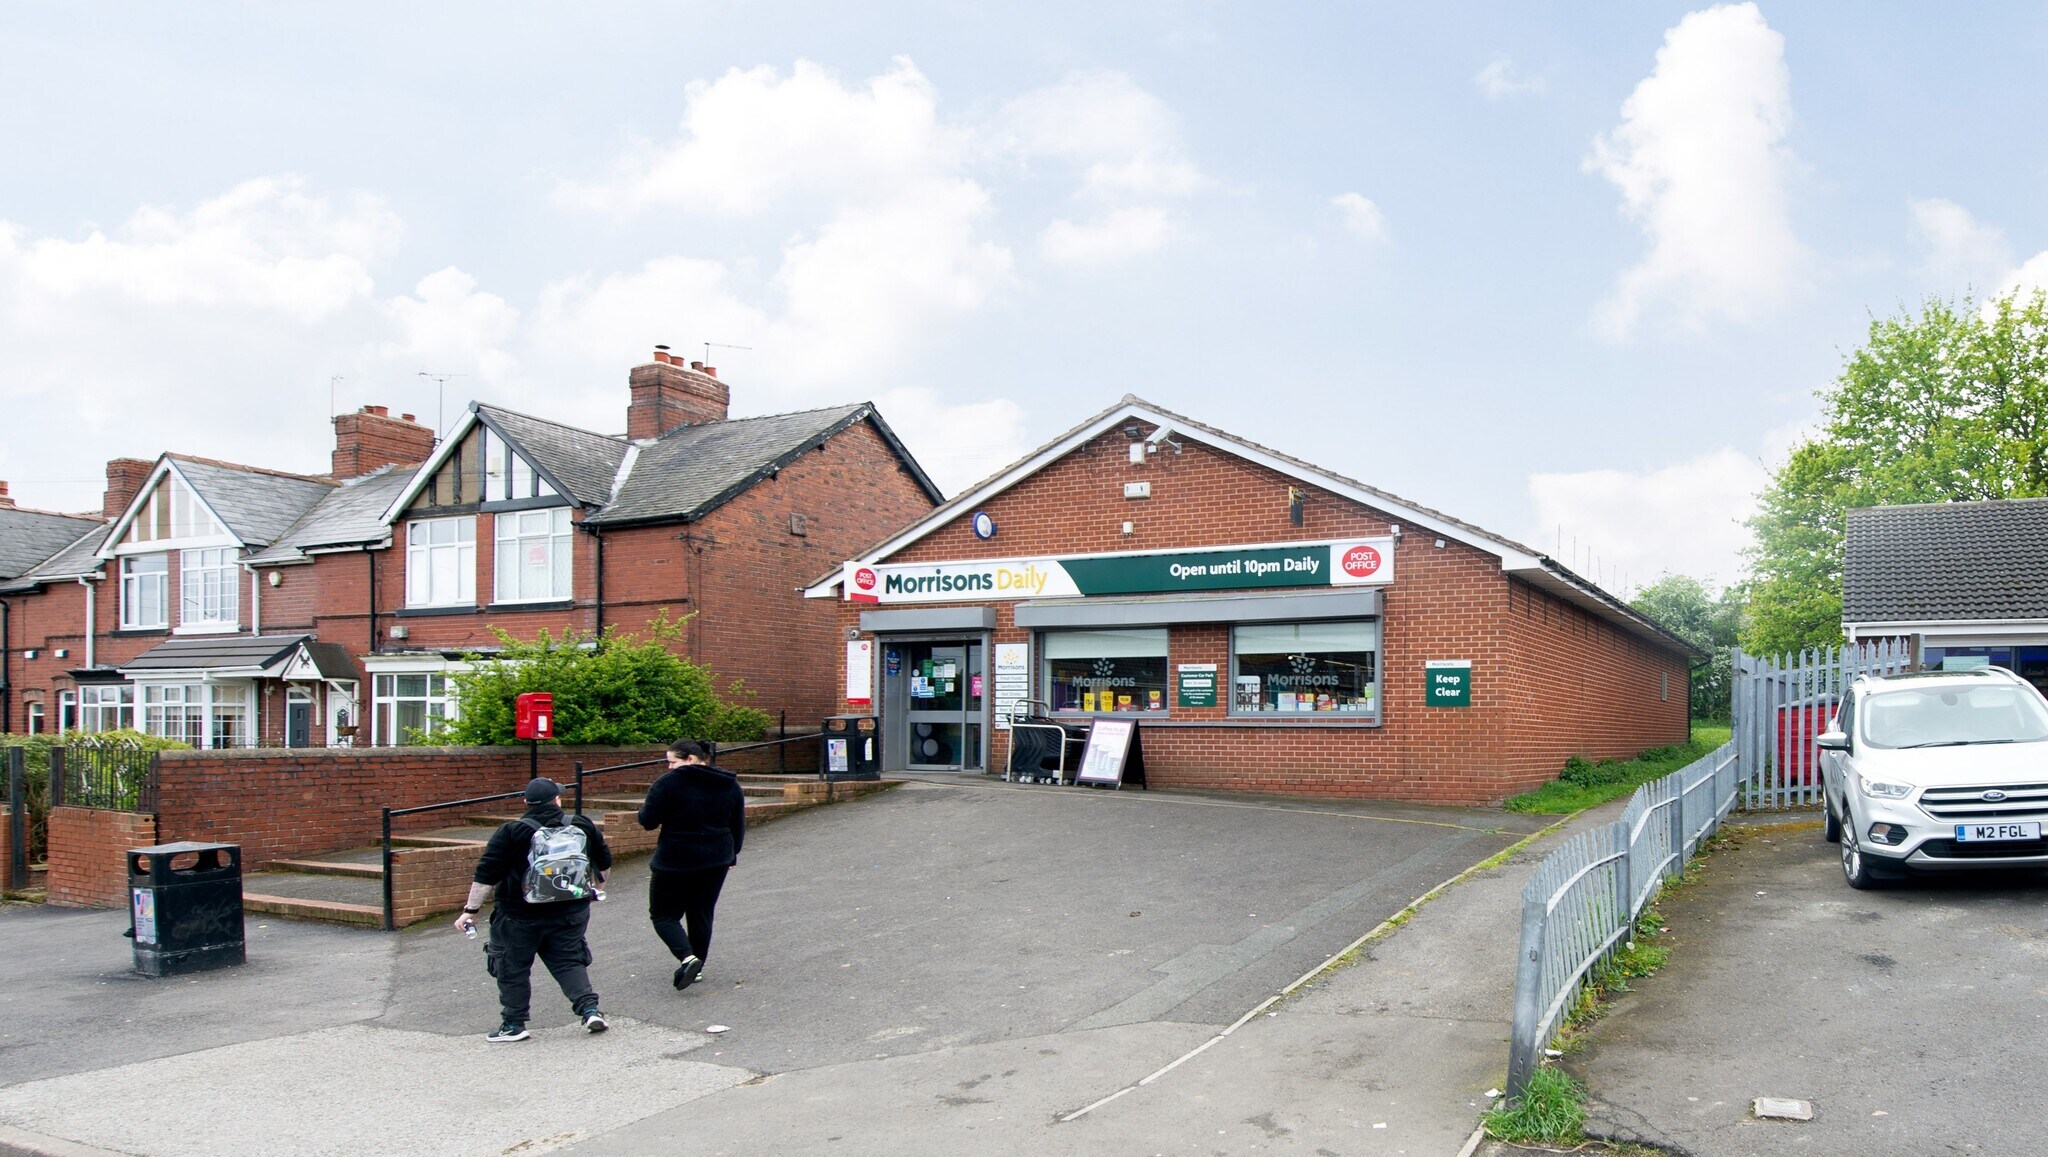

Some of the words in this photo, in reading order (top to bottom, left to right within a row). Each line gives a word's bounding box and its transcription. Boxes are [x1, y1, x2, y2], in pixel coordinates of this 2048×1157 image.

[1350, 552, 1374, 561] POST
[1169, 563, 1207, 580] Open
[1209, 559, 1241, 575] until
[1244, 559, 1281, 578] 10pm
[1283, 556, 1320, 574] Daily
[1345, 560, 1377, 570] OFFICE
[859, 571, 873, 579] POST
[885, 569, 993, 594] Morrisons
[997, 565, 1048, 595] Daily
[856, 577, 875, 586] OFFICE
[1072, 675, 1136, 688] Morrisons
[1267, 673, 1339, 686] Morrisons
[1435, 674, 1461, 686] Keep
[1435, 687, 1461, 697] Clear
[1976, 826, 1995, 839] M2
[1998, 825, 2028, 838] FGL
